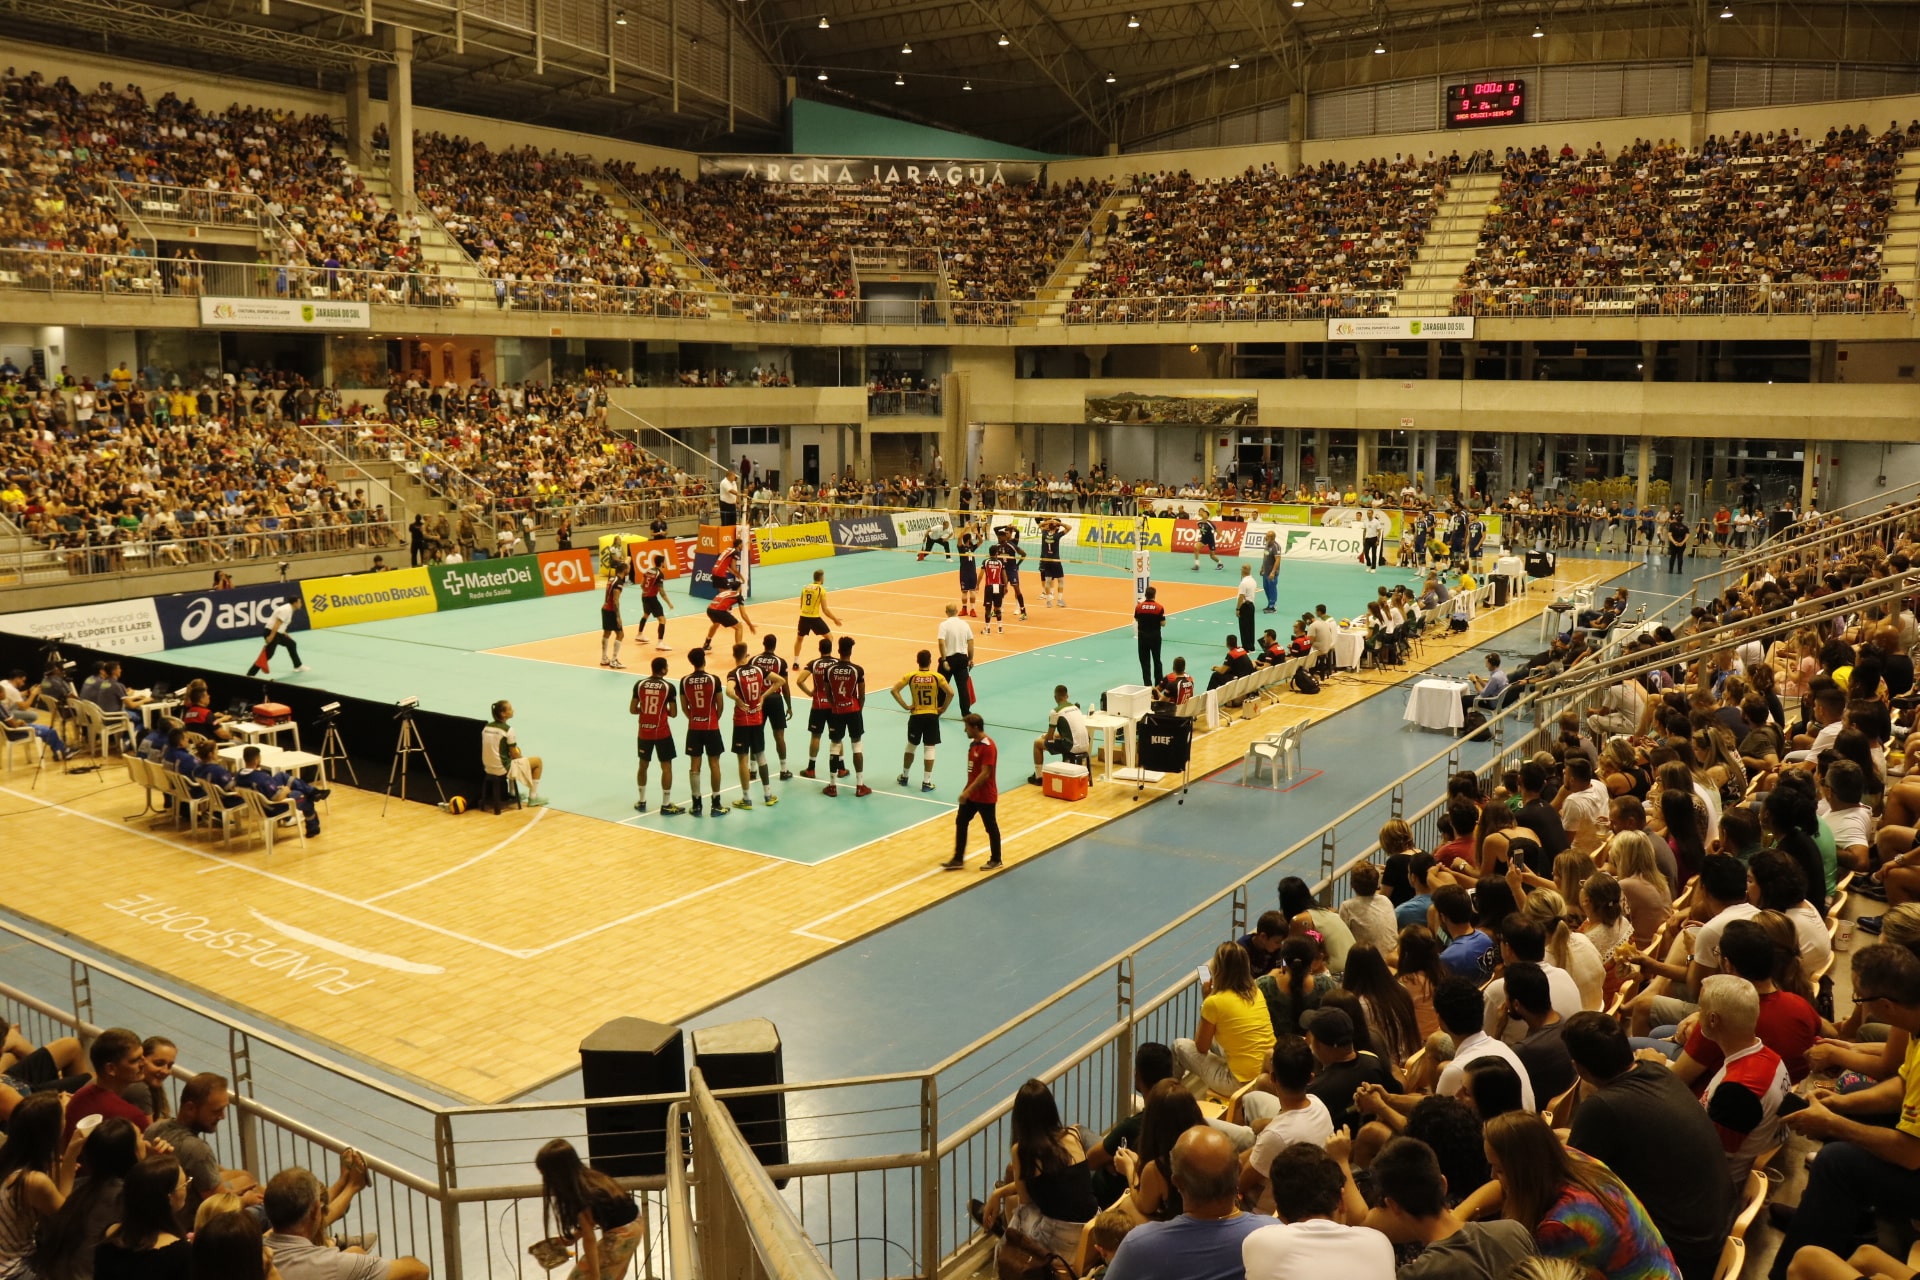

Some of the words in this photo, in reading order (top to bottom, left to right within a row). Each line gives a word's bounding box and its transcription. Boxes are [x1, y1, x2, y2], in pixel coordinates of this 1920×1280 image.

[1508, 83, 1515, 91] 0
[1462, 100, 1470, 110] 9
[1512, 95, 1520, 106] 8
[743, 163, 852, 183] ARENA
[315, 307, 342, 318] JARAGUÁ
[342, 309, 350, 319] DO
[350, 309, 360, 319] SUL
[1423, 321, 1446, 331] JARAGUÁ
[1447, 323, 1455, 331] DO
[1455, 323, 1465, 331] SUL
[852, 522, 882, 535] CANAL
[701, 536, 716, 548] GOL
[805, 534, 829, 547] BRASIL
[871, 531, 889, 541] BRASIL
[1310, 538, 1360, 553] FATOR
[464, 565, 532, 589] MaterDei
[543, 559, 591, 587] GOL
[991, 568, 997, 580] 7
[645, 578, 651, 588] 5
[331, 590, 374, 608] BANCO
[373, 588, 390, 603] DO
[390, 585, 431, 602] BRASIL
[469, 592, 484, 600] Rede
[485, 590, 493, 598] de
[493, 587, 512, 597] Saúde
[806, 594, 812, 605] 8
[87, 612, 134, 628] Municipal
[136, 612, 150, 620] de
[78, 625, 117, 638] ESPORTE
[118, 624, 124, 633] E
[125, 621, 152, 632] LAZER
[111, 638, 126, 646] DO
[134, 634, 156, 643] SUL
[757, 657, 775, 665] SESI
[645, 682, 663, 690] SESI
[689, 677, 708, 685] SESI
[747, 681, 760, 701] 19
[838, 681, 847, 697] 4
[694, 690, 705, 708] 6
[917, 690, 932, 706] 15
[644, 695, 660, 715] 18
[1151, 735, 1171, 746] KIEF
[103, 893, 376, 996] FUNDESPORTE
